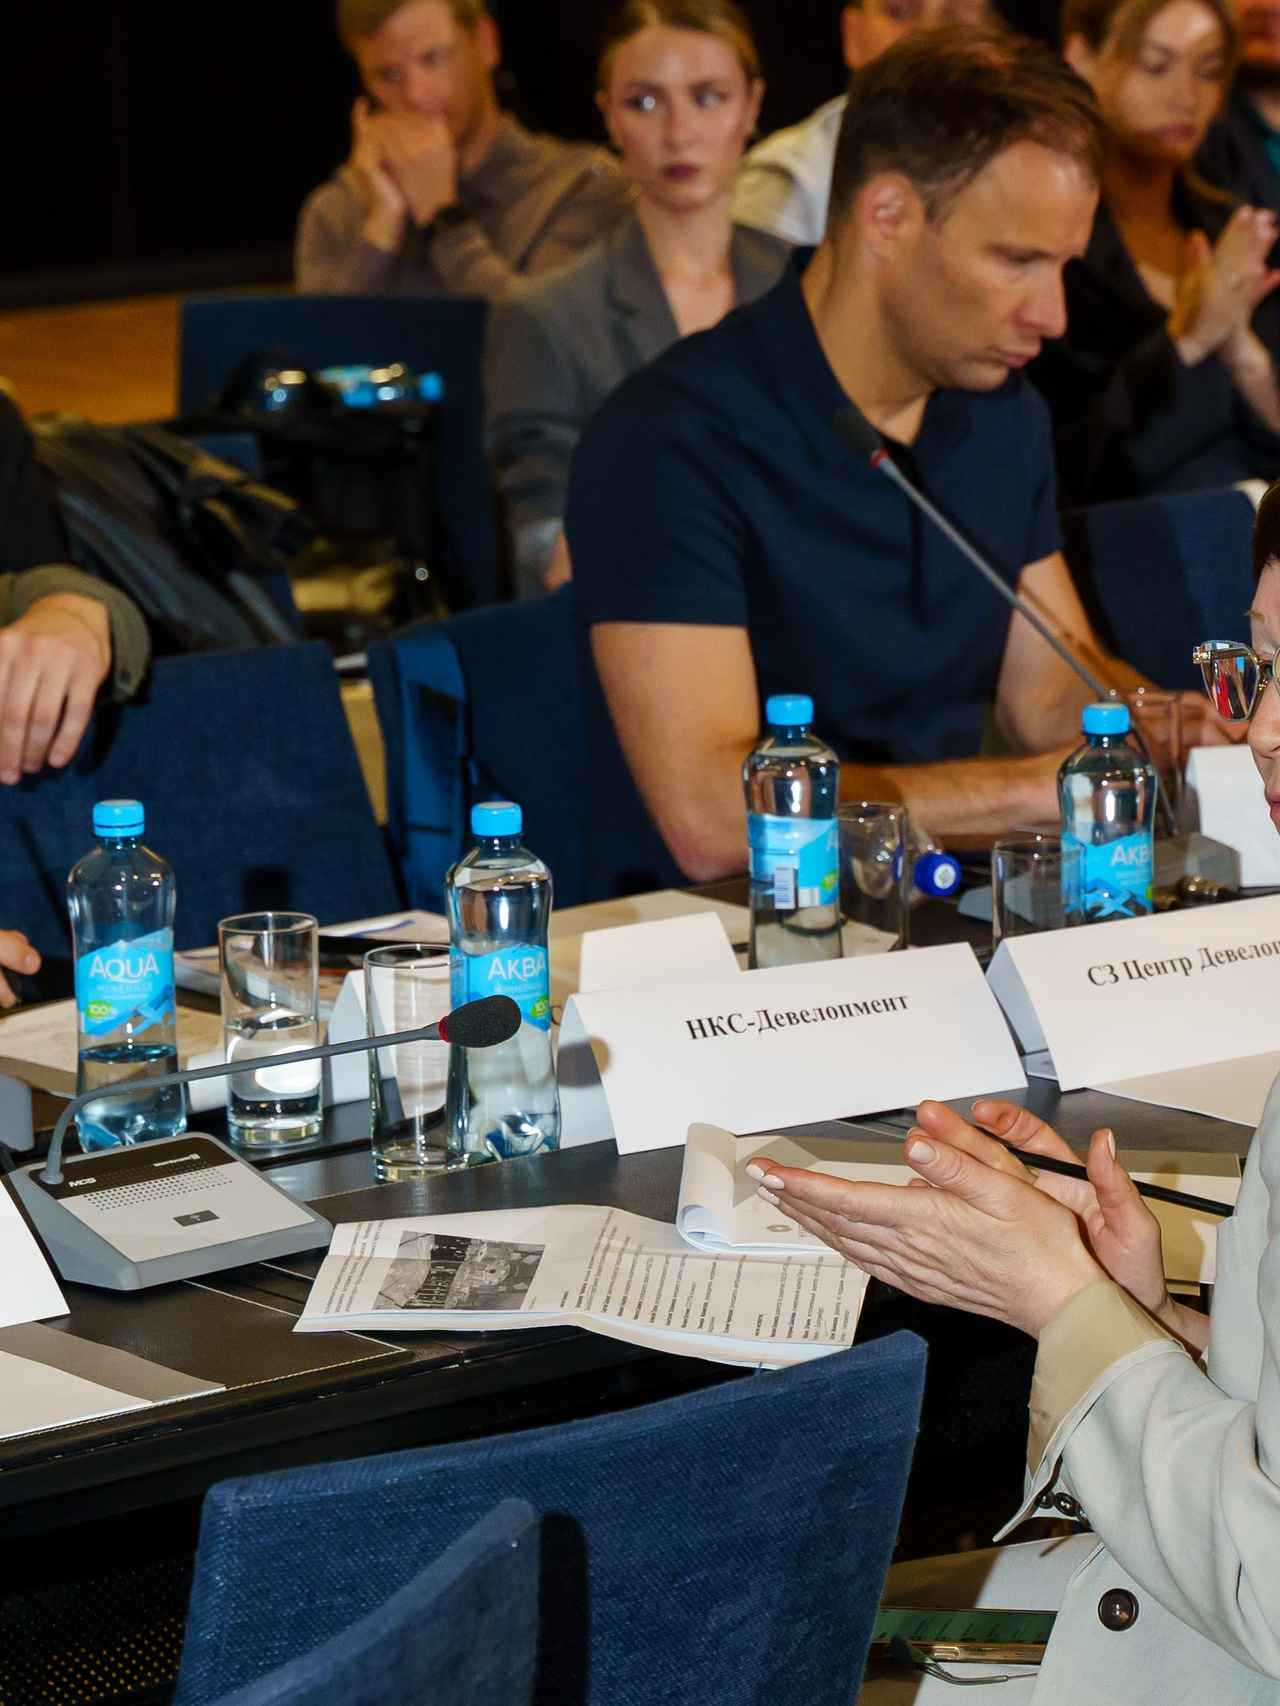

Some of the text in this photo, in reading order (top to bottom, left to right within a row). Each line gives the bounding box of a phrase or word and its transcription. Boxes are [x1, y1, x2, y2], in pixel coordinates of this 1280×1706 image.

[89, 952, 159, 984] AQUA
[487, 951, 547, 982] АКВА
[1121, 956, 1192, 982] Центр
[685, 995, 909, 1041] НКС-Девелопмент
[68, 1177, 97, 1188] MCS
